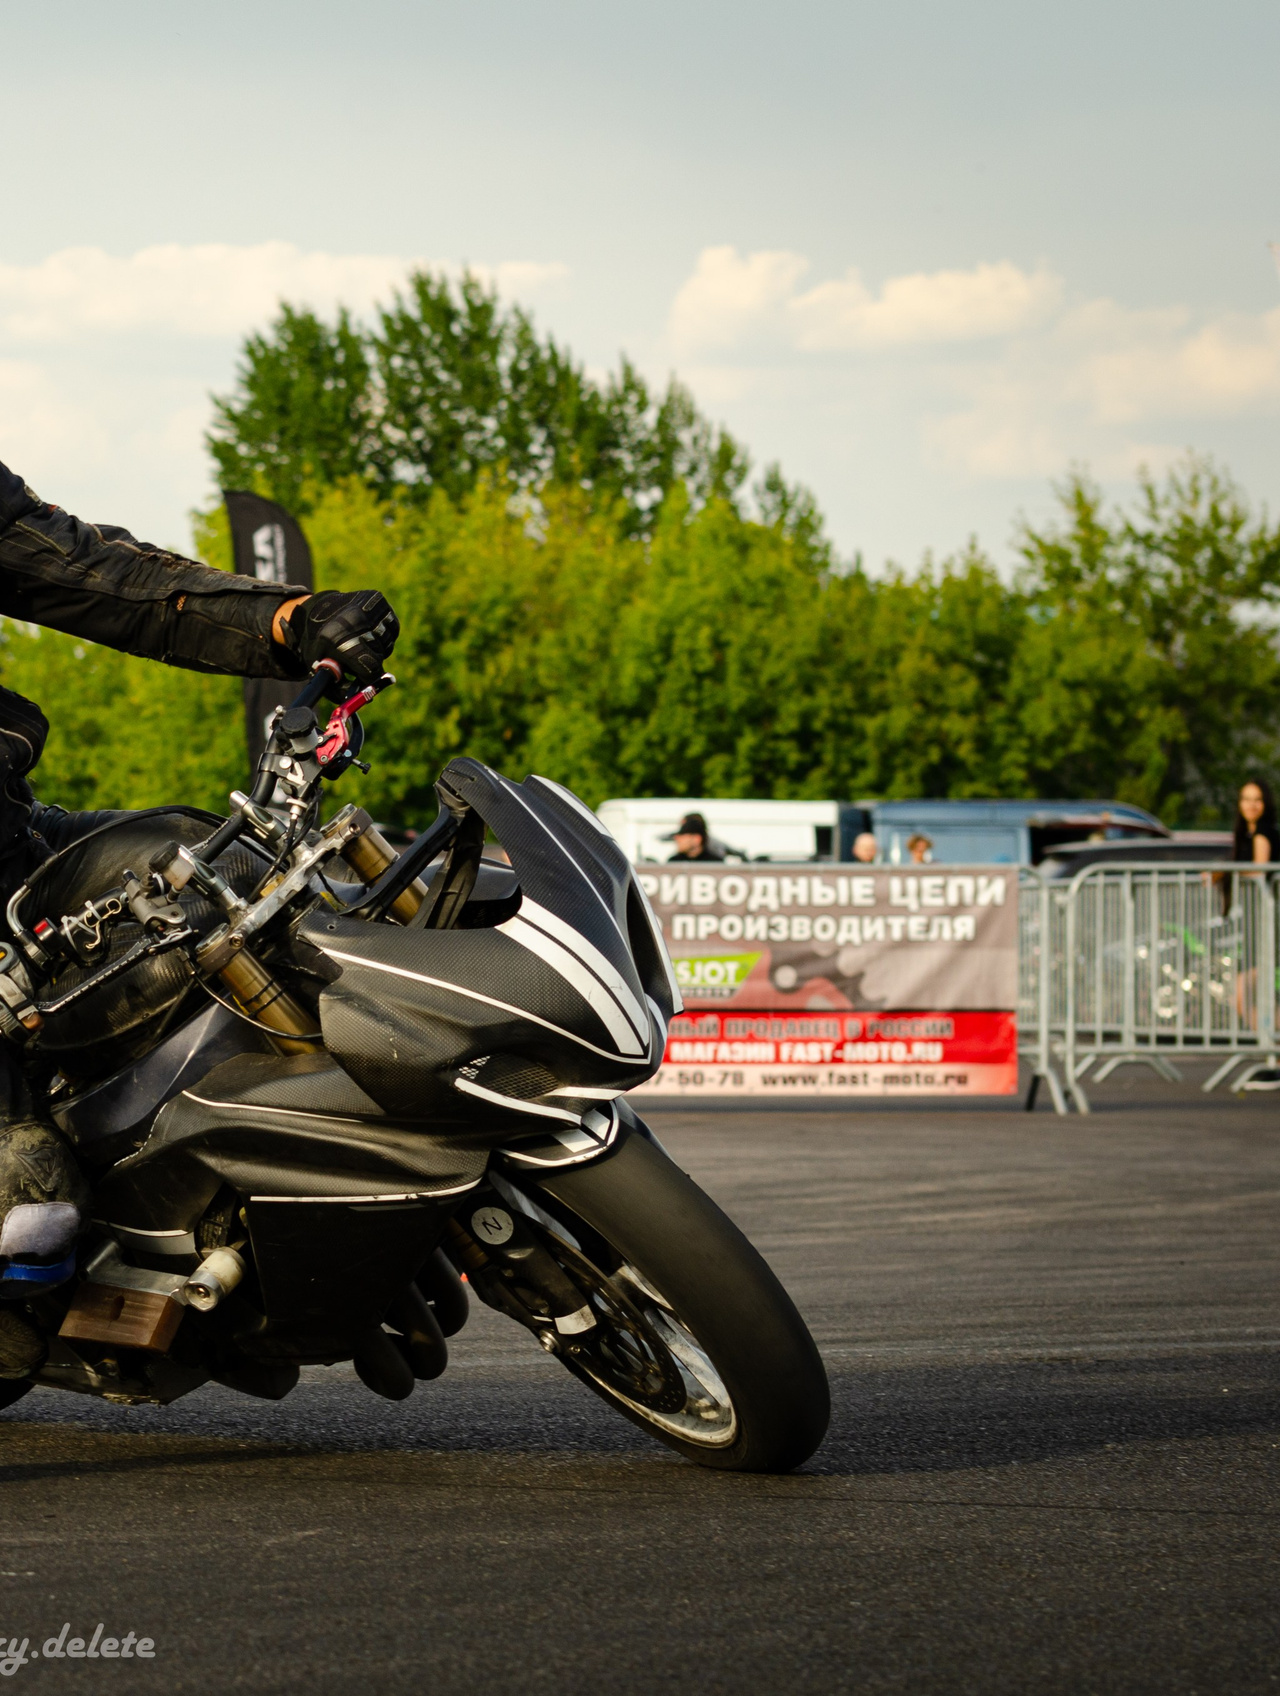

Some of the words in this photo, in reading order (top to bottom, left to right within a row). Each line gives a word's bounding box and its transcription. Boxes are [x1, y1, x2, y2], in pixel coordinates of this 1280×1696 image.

[889, 875, 1006, 912] ЦЕПИ
[671, 914, 976, 946] ПРОИЗВОДИТЕЛЯ
[672, 960, 740, 985] SJOT
[868, 1018, 954, 1038] РОССИИ
[780, 1041, 943, 1063] FAST-MOTO.RU
[760, 1070, 969, 1086] www.fast-moto.ru
